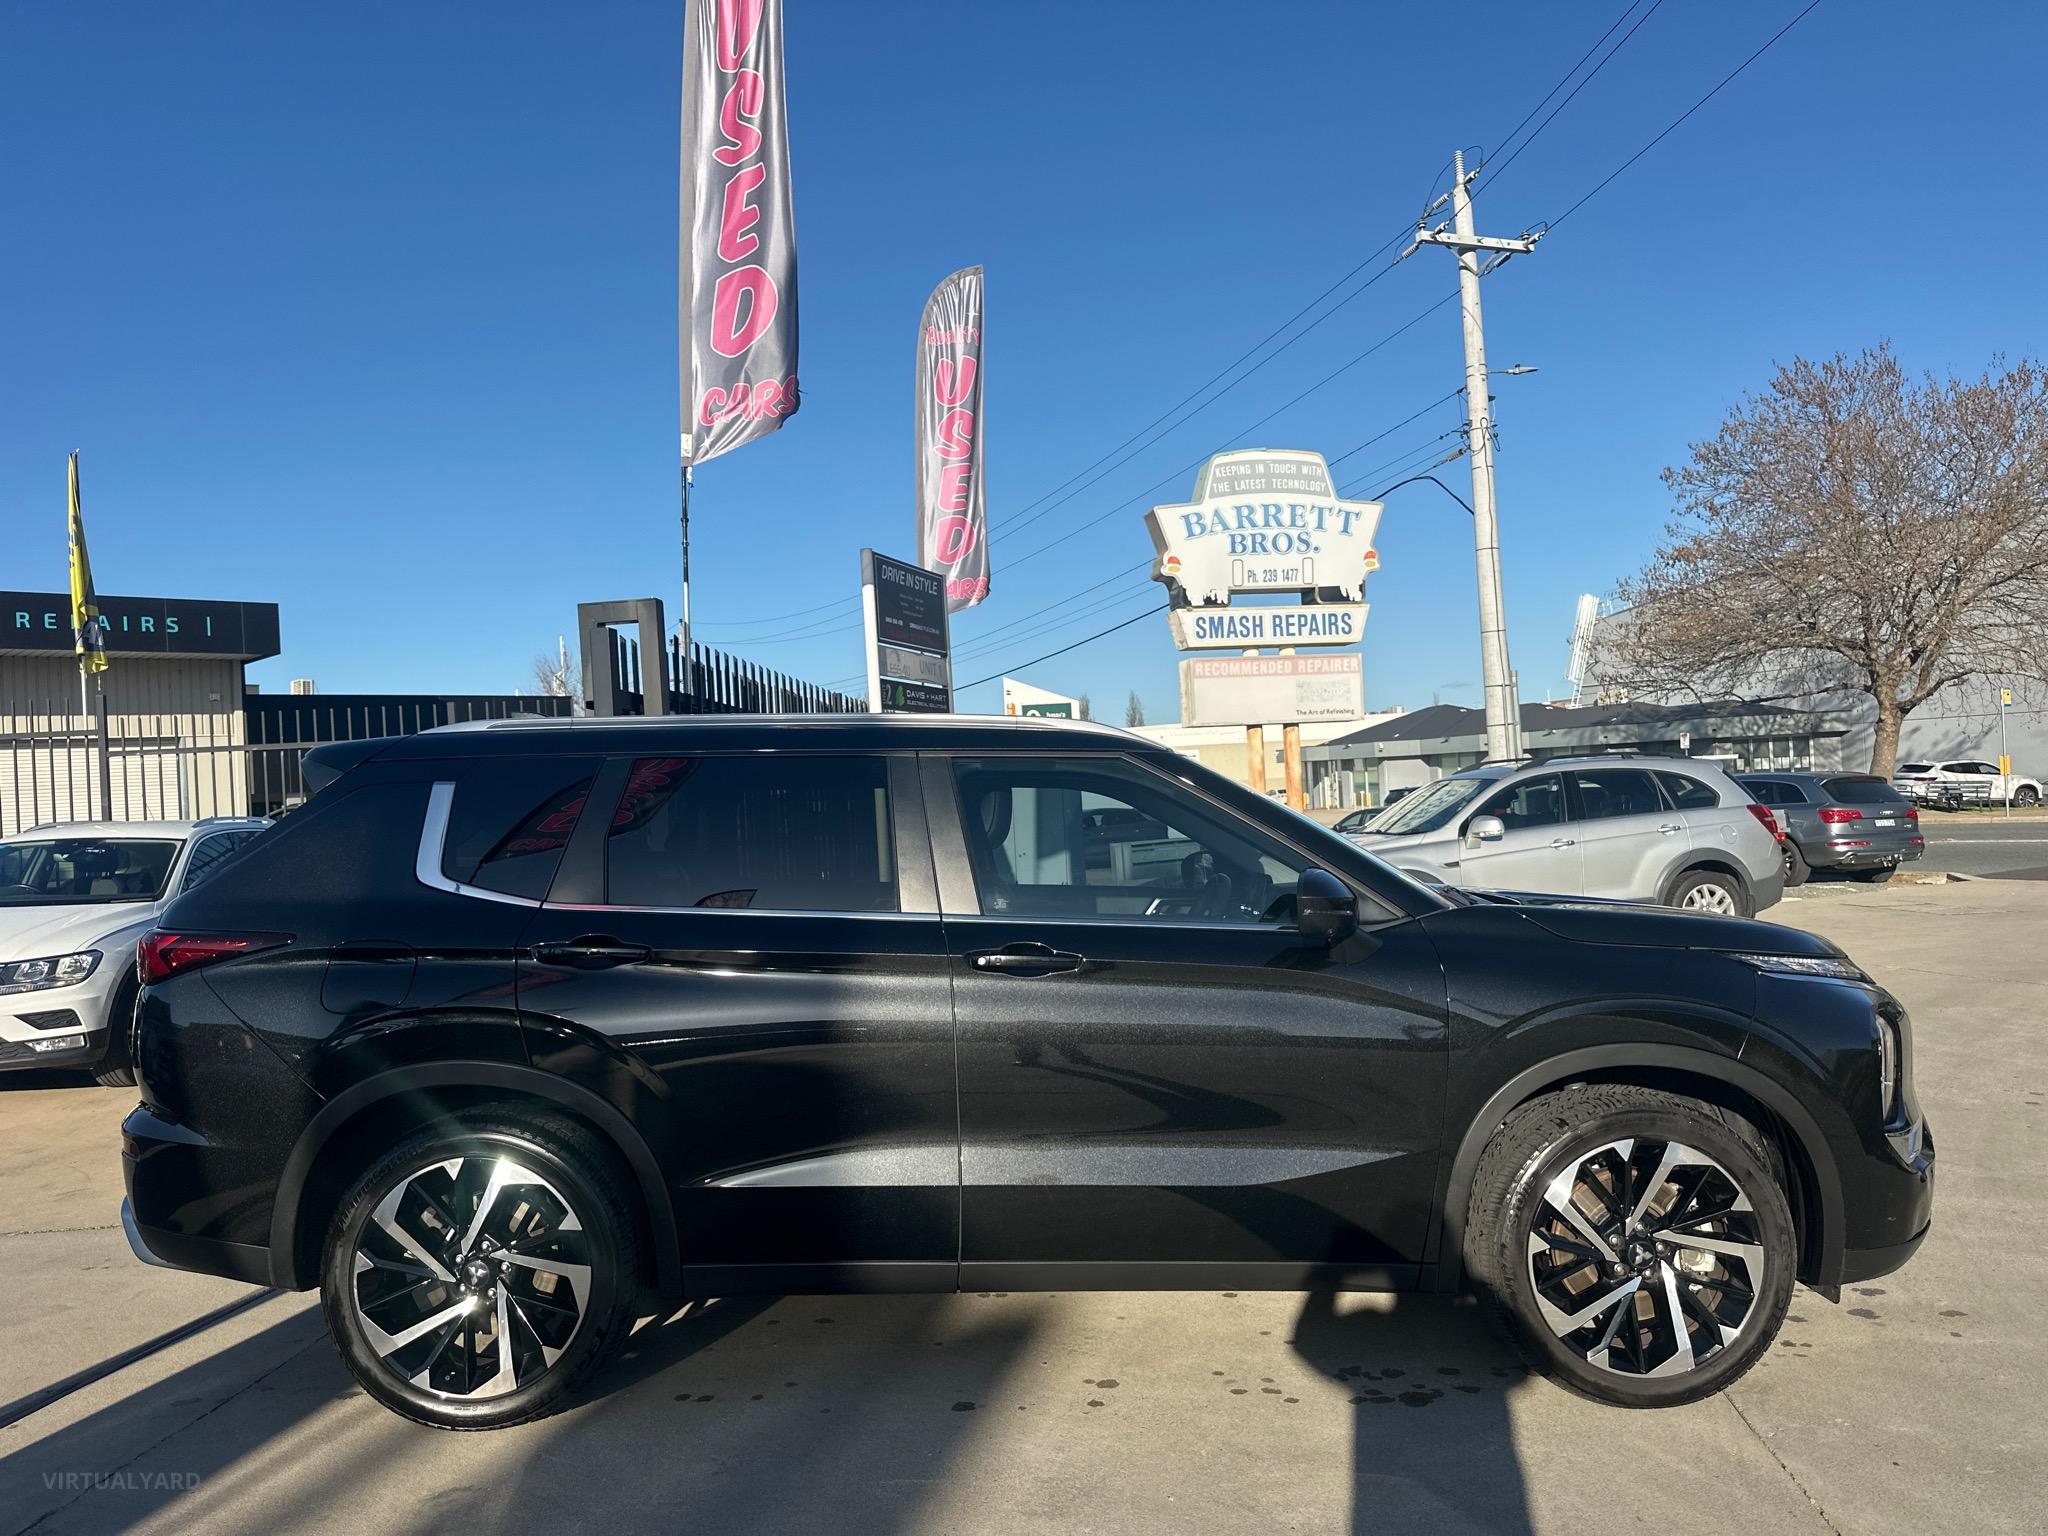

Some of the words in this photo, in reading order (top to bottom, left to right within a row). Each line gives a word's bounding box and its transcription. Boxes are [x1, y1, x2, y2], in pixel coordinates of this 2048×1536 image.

[711, 0, 778, 358] USED
[699, 374, 800, 427] CARS
[933, 354, 977, 565] USED
[1214, 464, 1251, 478] KEEPING
[1255, 463, 1265, 474] IN
[1269, 463, 1297, 474] TOUCH
[1301, 465, 1322, 477] WITH
[1213, 482, 1231, 494] THE
[1234, 479, 1266, 491] LATEST
[1272, 479, 1327, 492] TECHNOLOGY
[1180, 503, 1361, 541] BARRETT
[1228, 532, 1321, 555] BROS.
[882, 565, 905, 585] DRIVE
[905, 572, 914, 588] IN
[914, 576, 938, 595] STYLE
[1247, 570, 1259, 583] Ph.
[1263, 570, 1278, 583] 239
[1282, 569, 1299, 582] 1477
[946, 577, 988, 599] ARS
[15, 611, 180, 634] REAIRS
[1195, 615, 1264, 640] SMASH
[1272, 612, 1353, 637] REPAIRS
[1195, 661, 1293, 677] RECOMMENDED
[1298, 657, 1360, 674] REPAIRER
[906, 689, 926, 700] DAVIS
[930, 694, 947, 703] HART
